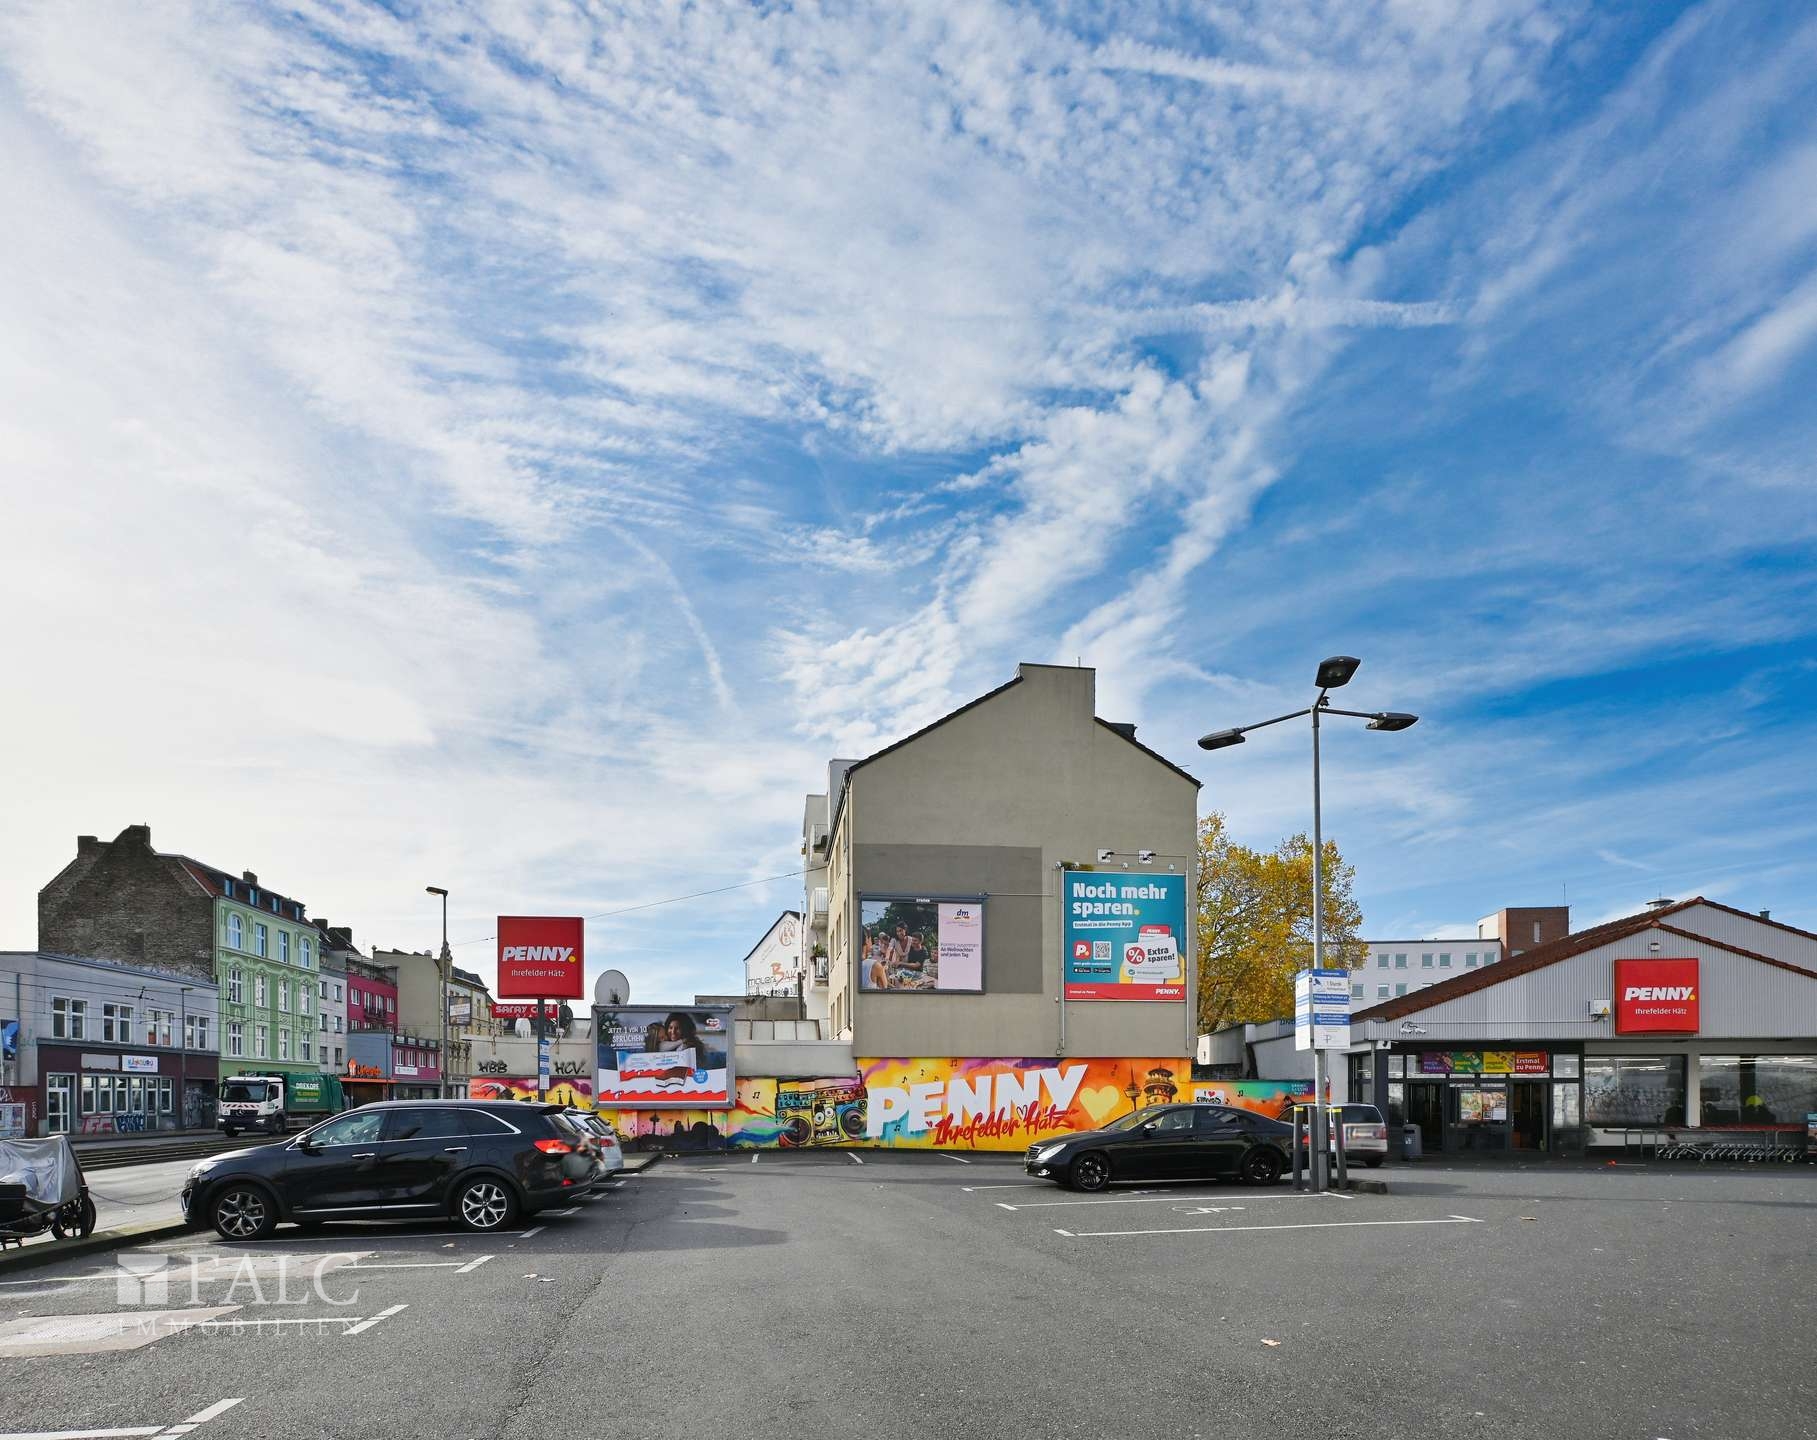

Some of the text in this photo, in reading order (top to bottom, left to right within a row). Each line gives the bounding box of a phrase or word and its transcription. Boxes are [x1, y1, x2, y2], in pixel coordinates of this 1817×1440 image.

[1073, 883, 1168, 899] Noch mehr
[1072, 902, 1139, 917] sparen.
[1147, 947, 1169, 956] Extra
[1147, 953, 1176, 963] sparen!
[511, 969, 566, 977] Ihrefelder Hätz
[1635, 1007, 1687, 1015] Ihrefelder Hätz
[1525, 1064, 1545, 1072] Penny
[866, 1064, 1088, 1137] PENNY
